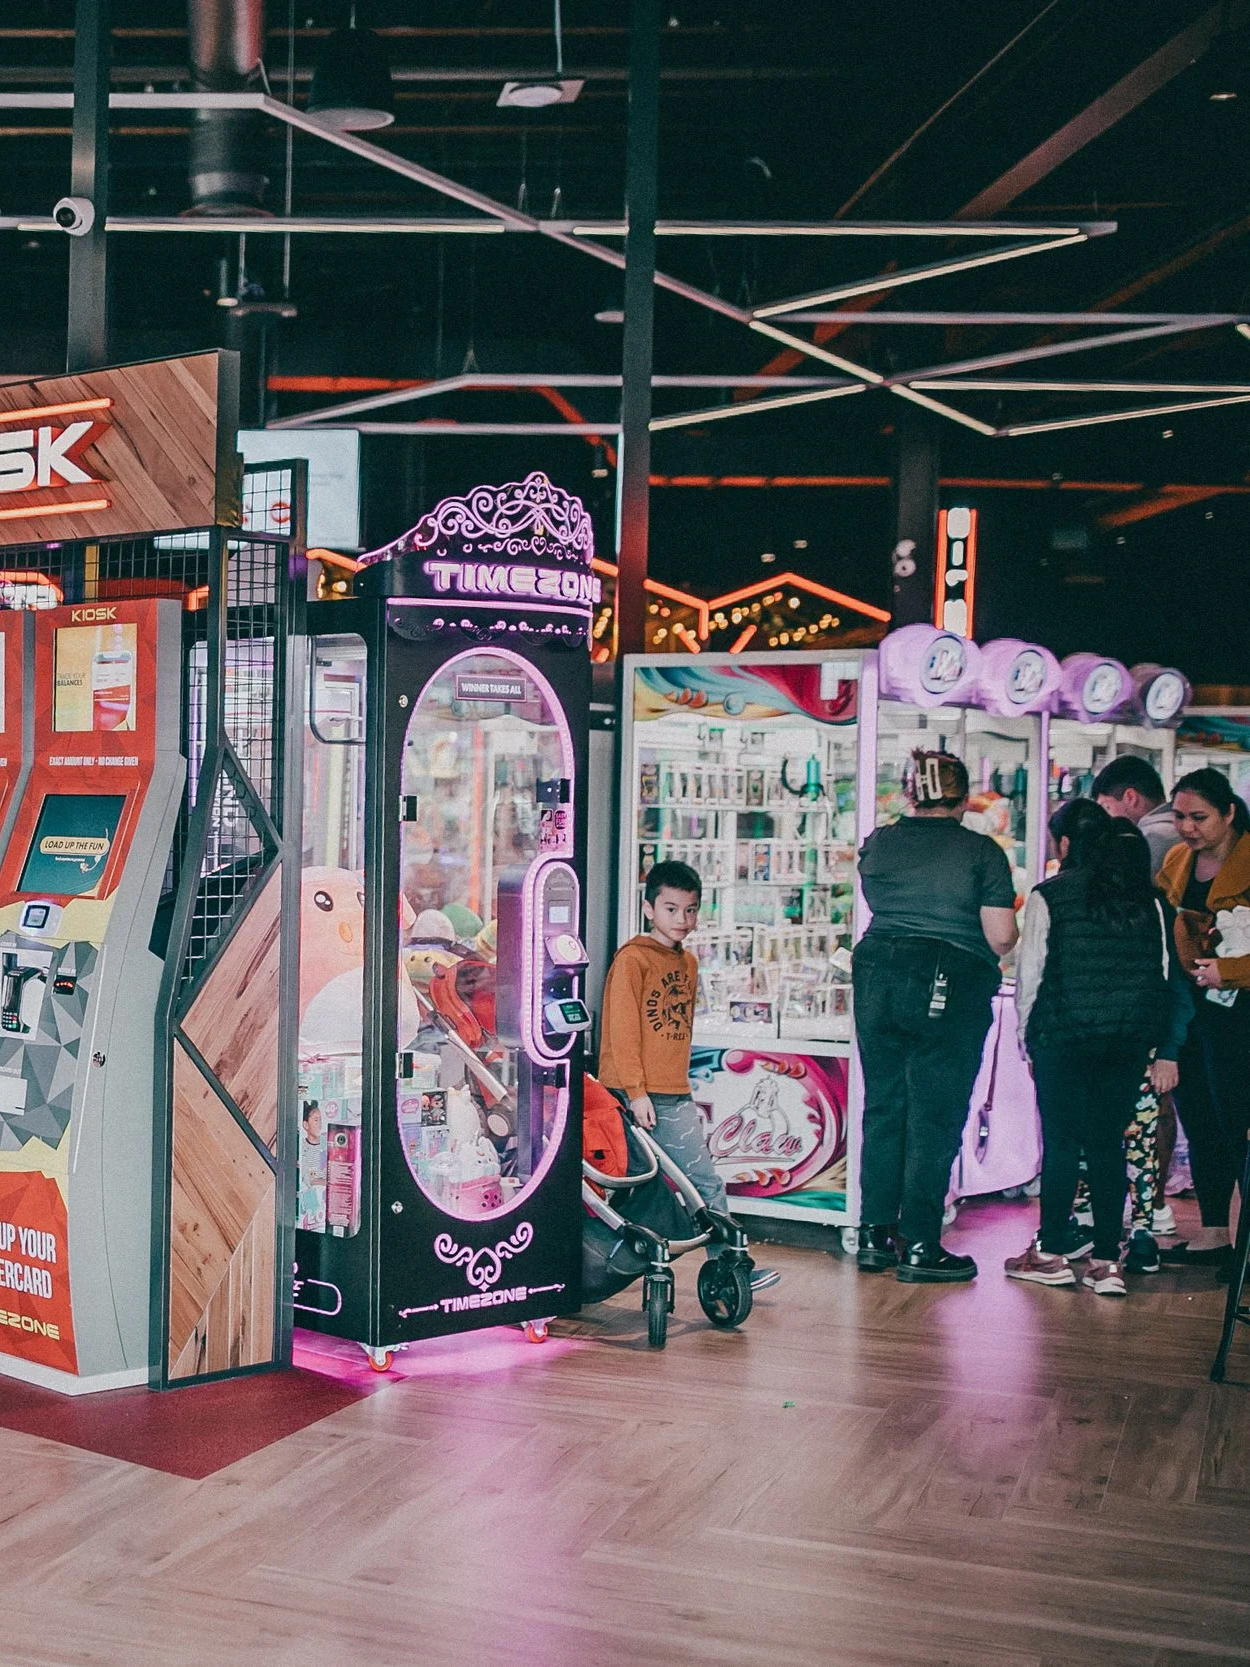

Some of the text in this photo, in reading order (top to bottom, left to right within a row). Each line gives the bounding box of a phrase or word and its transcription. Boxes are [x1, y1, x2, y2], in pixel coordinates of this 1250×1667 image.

[71, 607, 117, 622] KIOSK
[57, 679, 83, 687] BALANCES
[461, 683, 521, 694] WINNER TAKES ALL
[45, 840, 64, 848] LOAD
[64, 841, 75, 849] UP
[89, 842, 104, 850] FUN
[647, 990, 663, 1032] DINOS
[661, 971, 680, 988] ARE
[708, 1115, 802, 1158] Claw
[17, 1225, 57, 1264] YOUR
[440, 1286, 527, 1313] TIMEZONE
